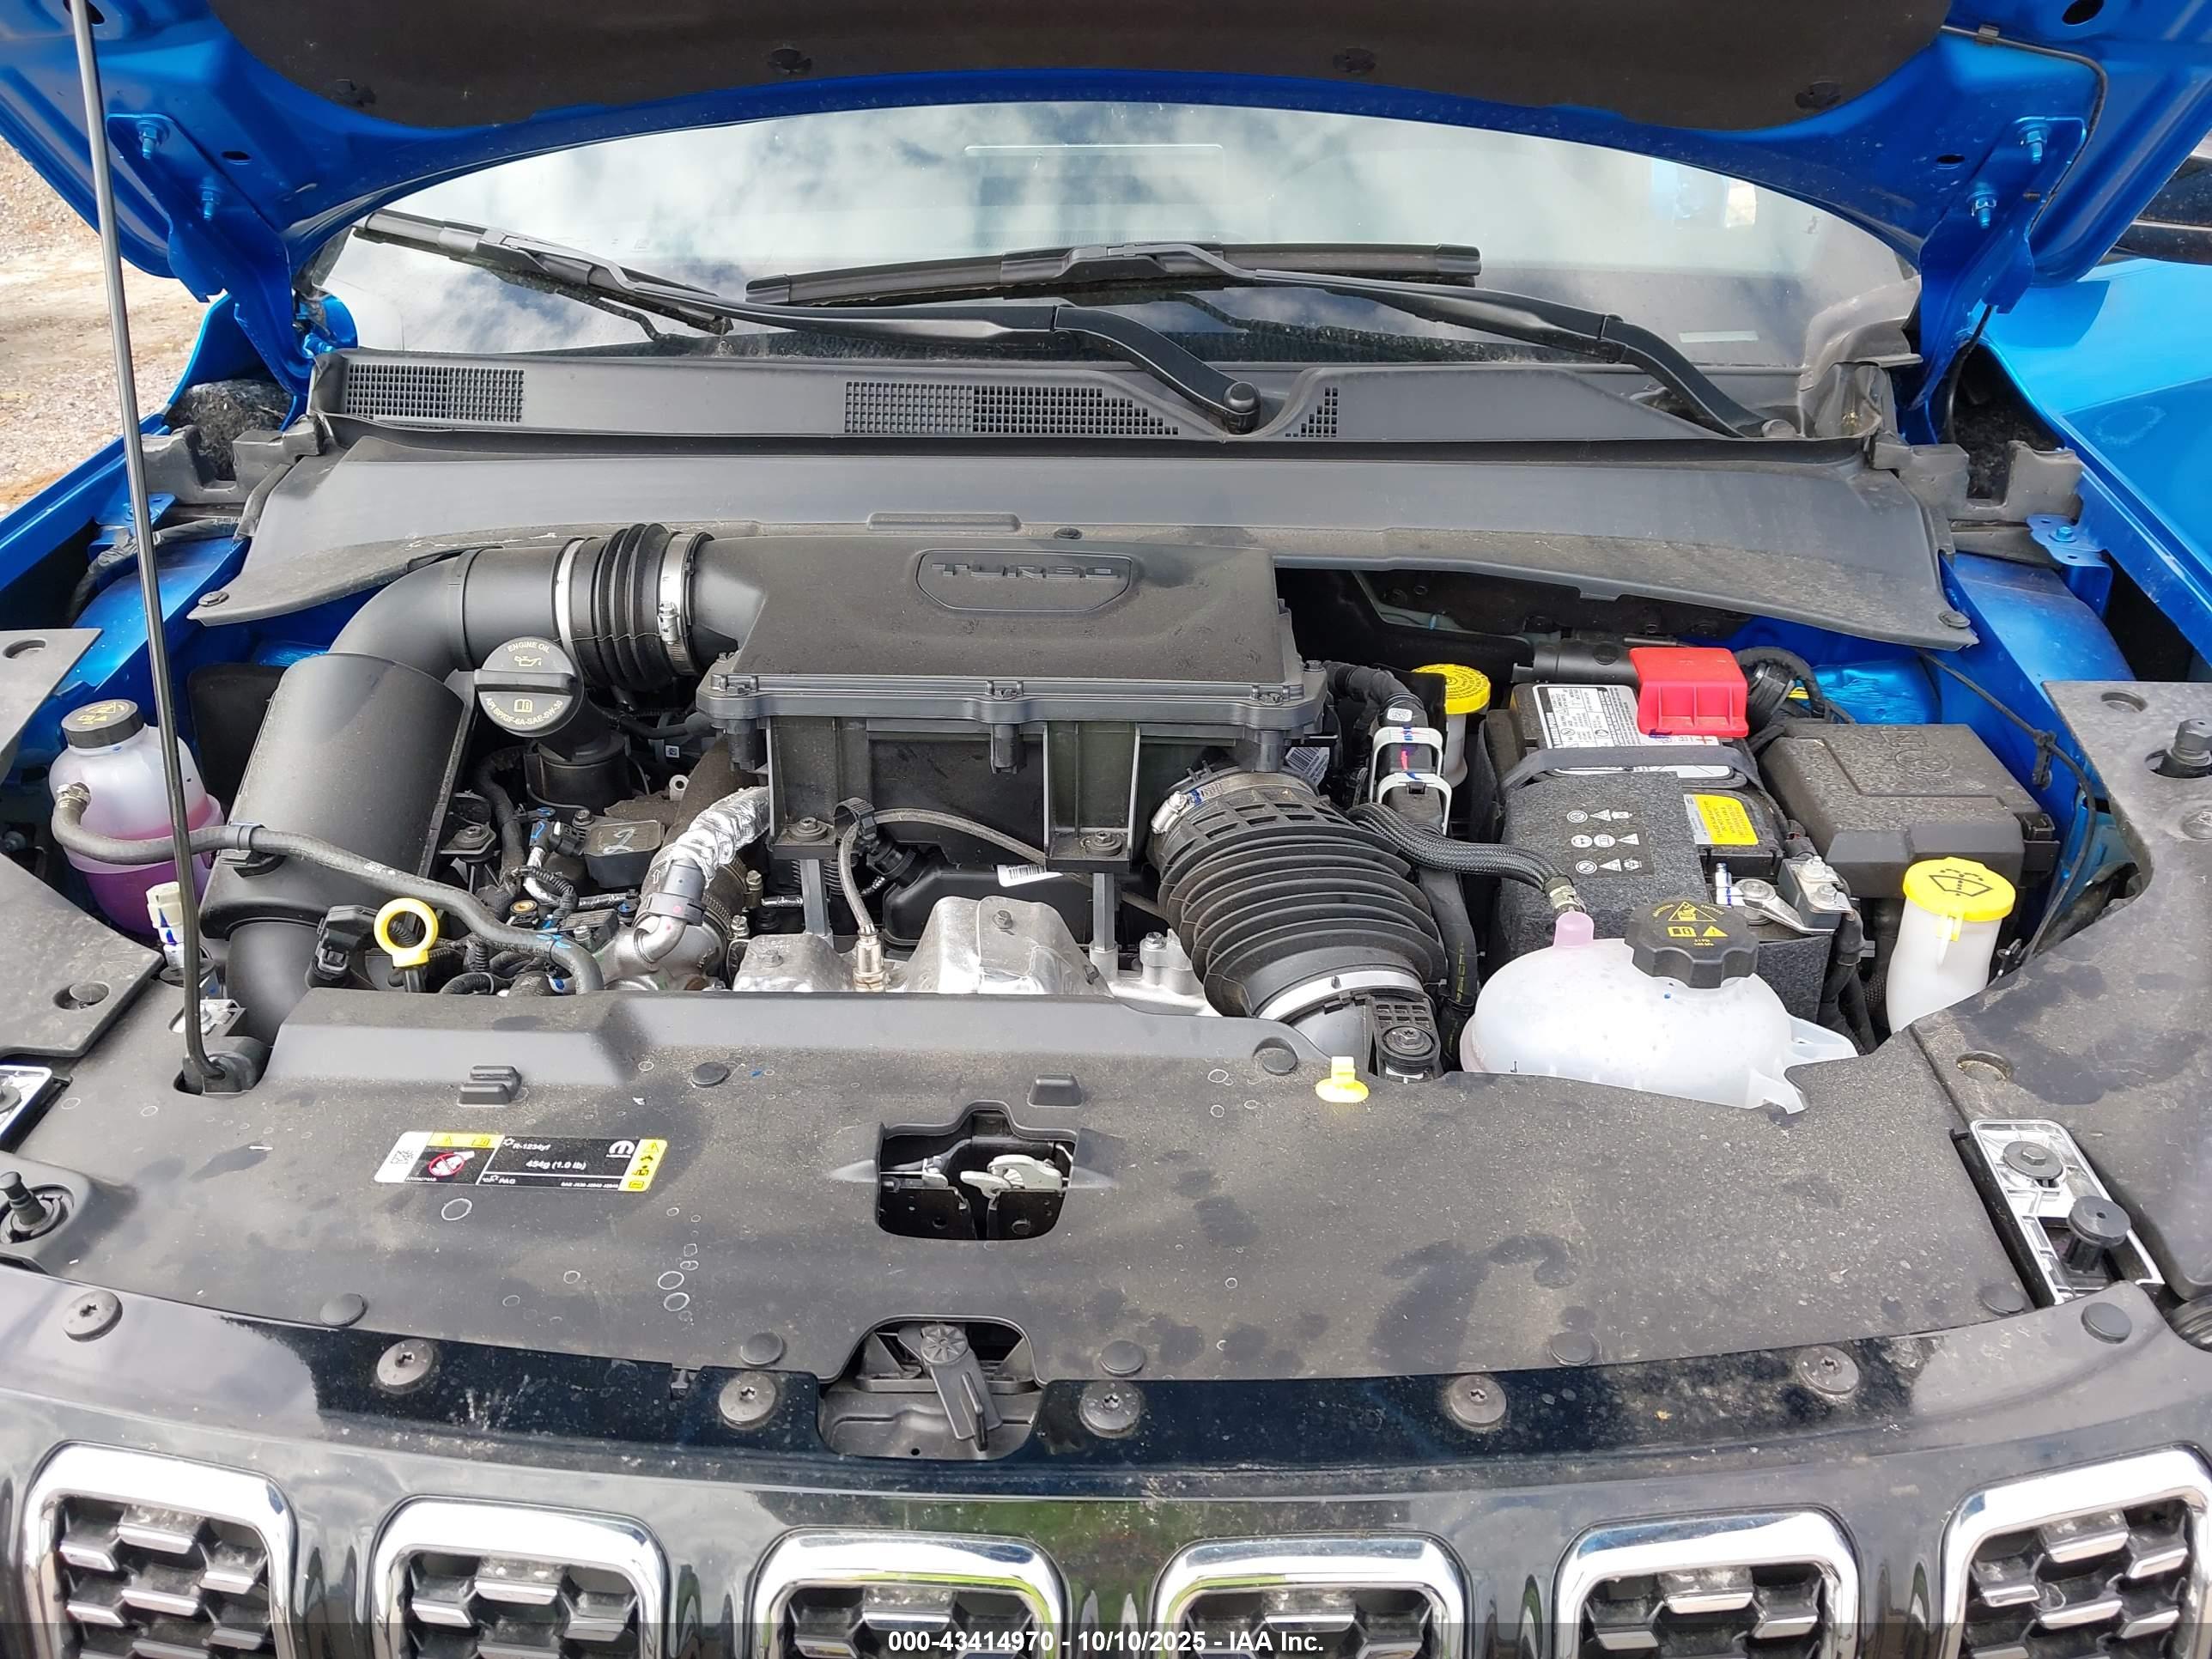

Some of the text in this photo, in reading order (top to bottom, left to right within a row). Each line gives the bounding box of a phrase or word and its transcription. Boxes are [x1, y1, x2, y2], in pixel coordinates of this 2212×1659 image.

[507, 641, 550, 653] ENGINE OIL
[484, 697, 496, 710] API
[512, 1142, 551, 1152] R-1234yf
[526, 1160, 550, 1170] 454g
[552, 1161, 571, 1170] (1.0
